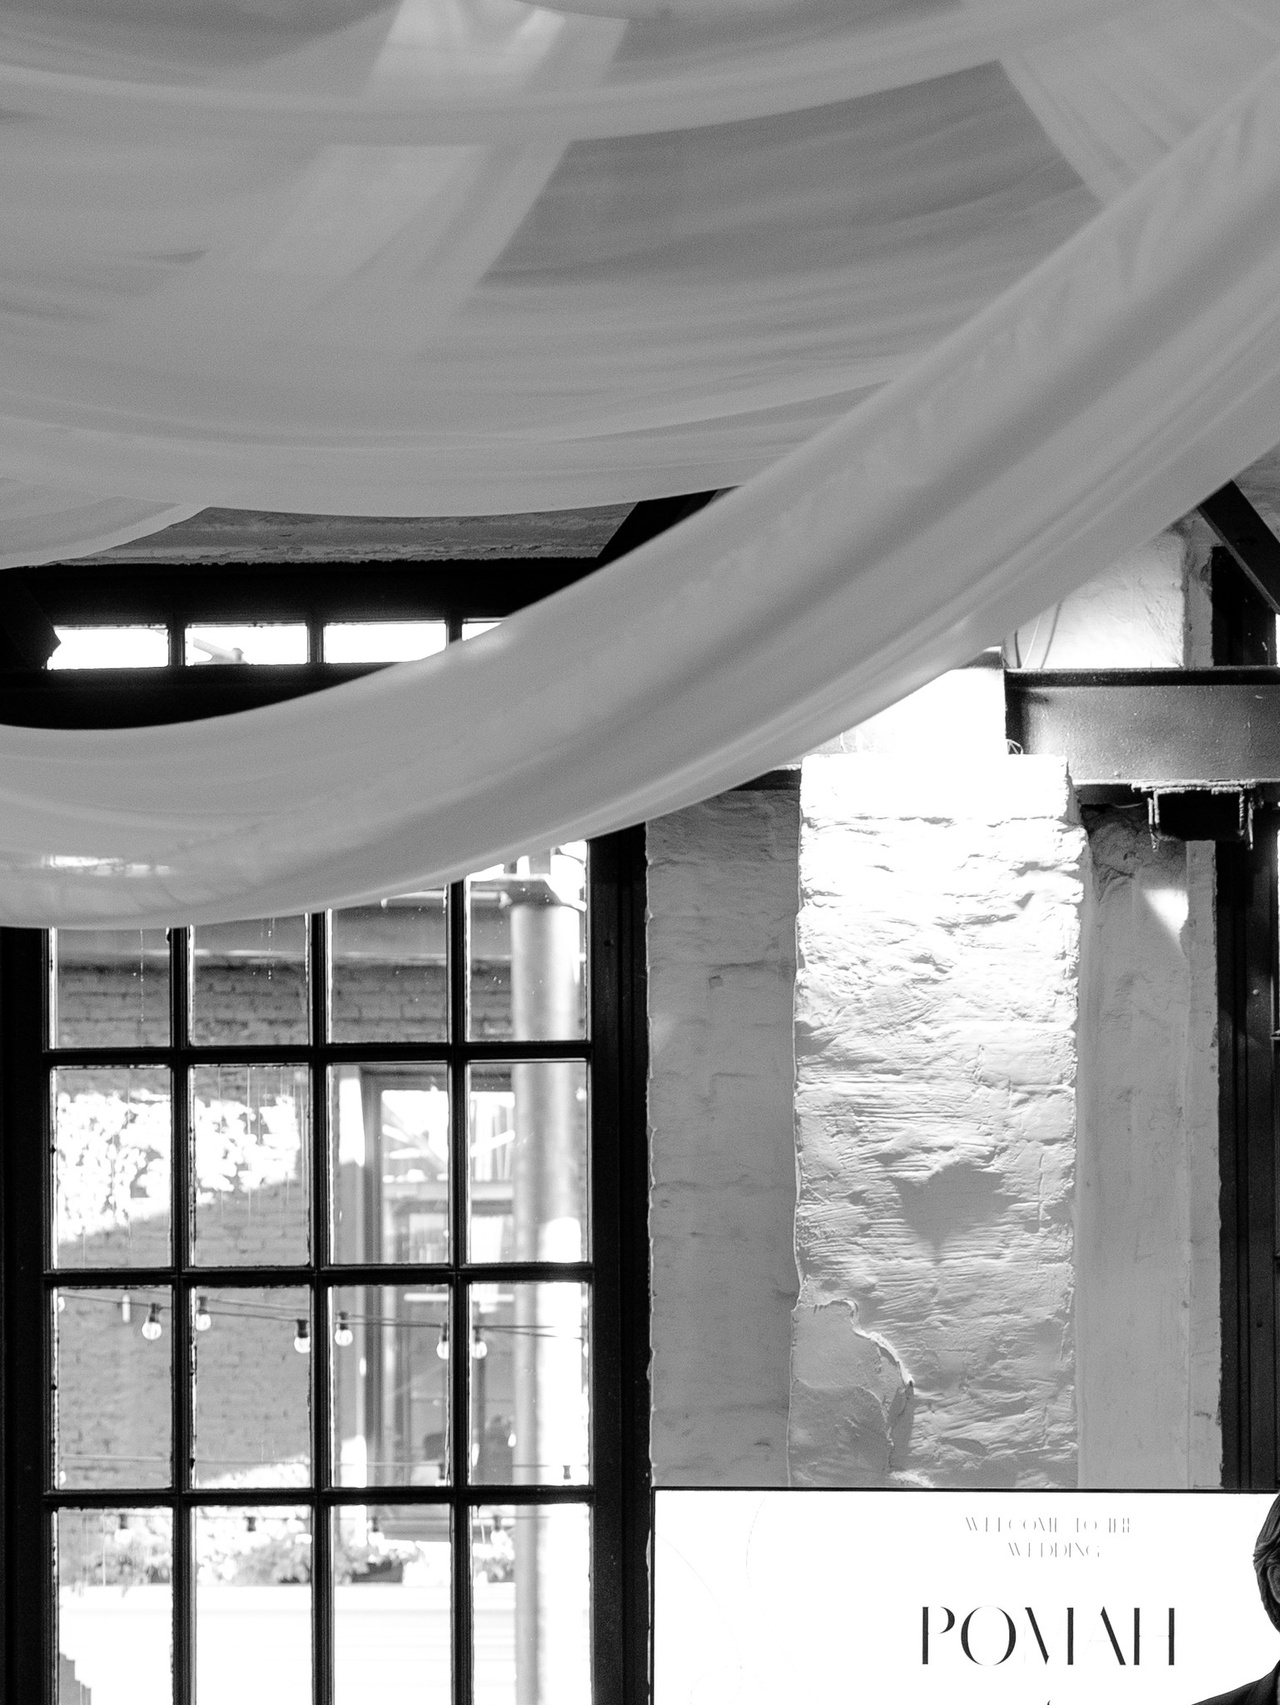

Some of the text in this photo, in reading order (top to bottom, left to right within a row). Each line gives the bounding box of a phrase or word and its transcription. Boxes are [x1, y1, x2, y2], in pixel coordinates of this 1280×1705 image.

[965, 1516, 1061, 1533] WELCOME
[1073, 1516, 1098, 1533] TO
[1008, 1541, 1101, 1558] WEDDING
[921, 1605, 1176, 1667] РОМАН
